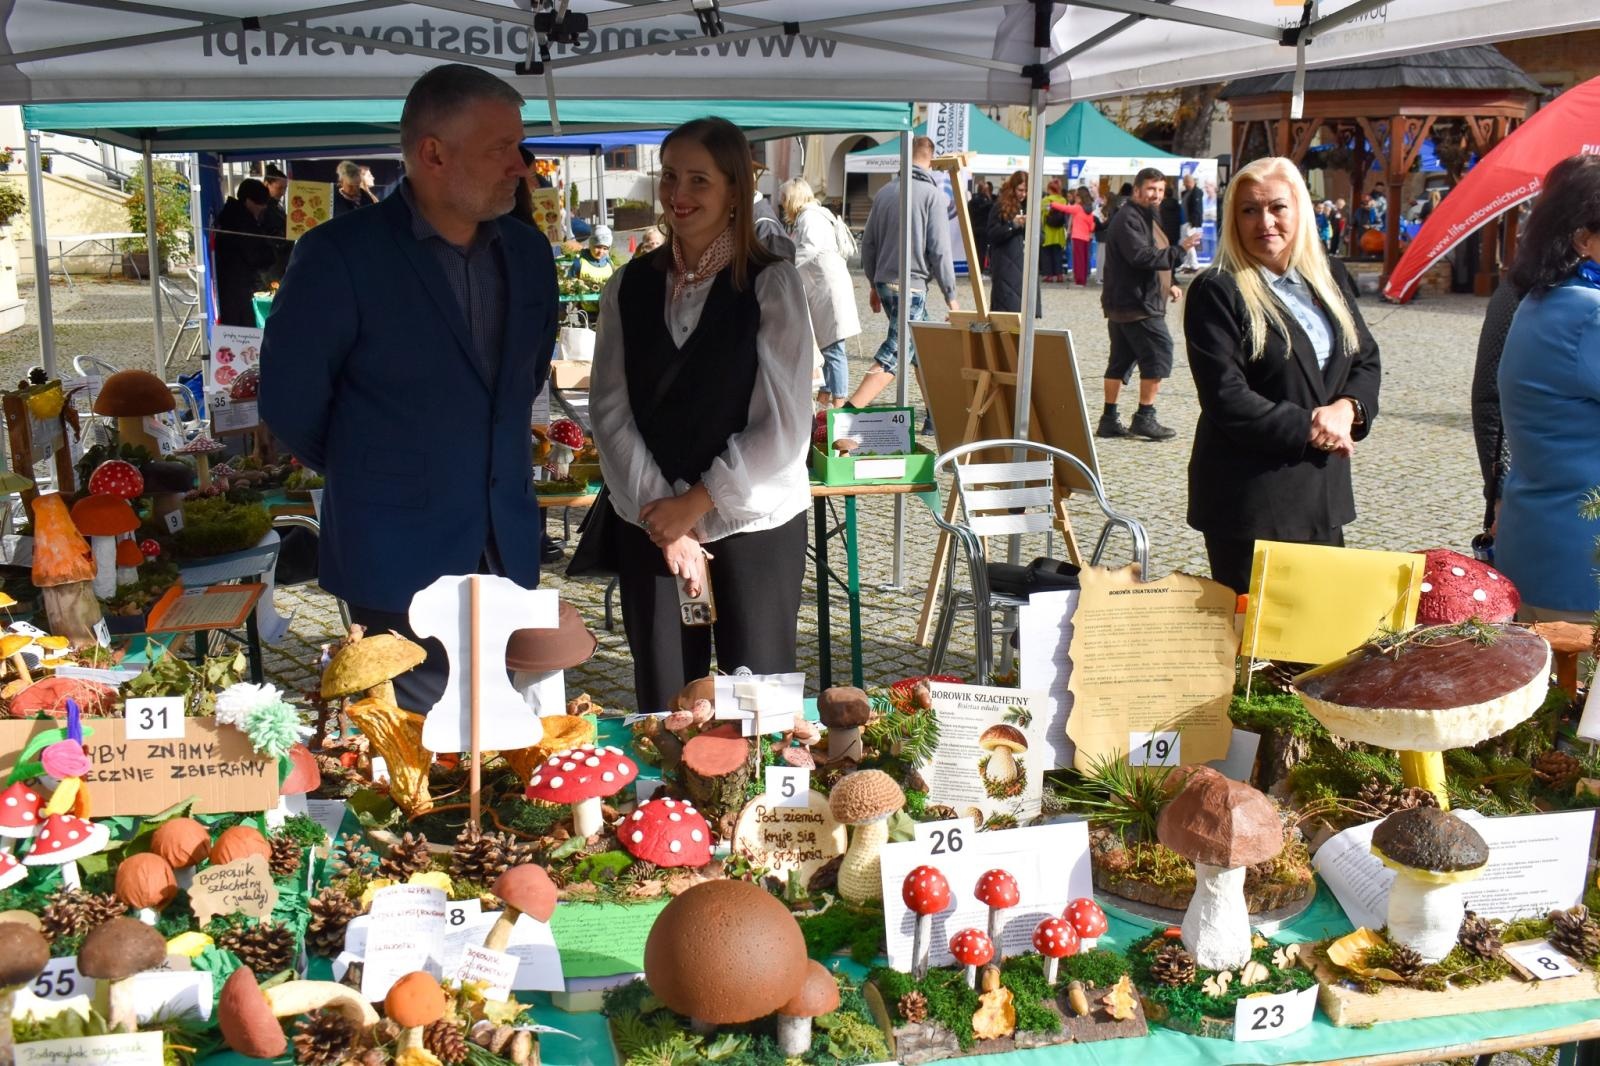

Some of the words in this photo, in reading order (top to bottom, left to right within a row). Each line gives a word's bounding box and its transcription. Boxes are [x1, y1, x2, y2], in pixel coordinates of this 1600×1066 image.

[1581, 143, 1600, 156] PU
[1426, 176, 1541, 259] www.life-ratownictwo.pl
[214, 396, 226, 407] 35
[891, 414, 905, 424] 40
[170, 515, 178, 528] 9
[931, 690, 972, 702] BOROWIK
[974, 693, 1030, 706] SZLACHETNY
[139, 706, 169, 731] 31
[147, 742, 214, 760] ZNAMY
[1142, 739, 1169, 759] 19
[170, 760, 266, 779] ZBIERAMY
[781, 775, 796, 798] 5
[755, 805, 781, 823] Pod
[763, 828, 793, 849] kryje
[797, 829, 817, 845] się
[929, 827, 963, 855] 26
[445, 908, 466, 926] 8
[1536, 956, 1561, 972] 8
[34, 968, 76, 998] 55
[1250, 1004, 1285, 1031] 23
